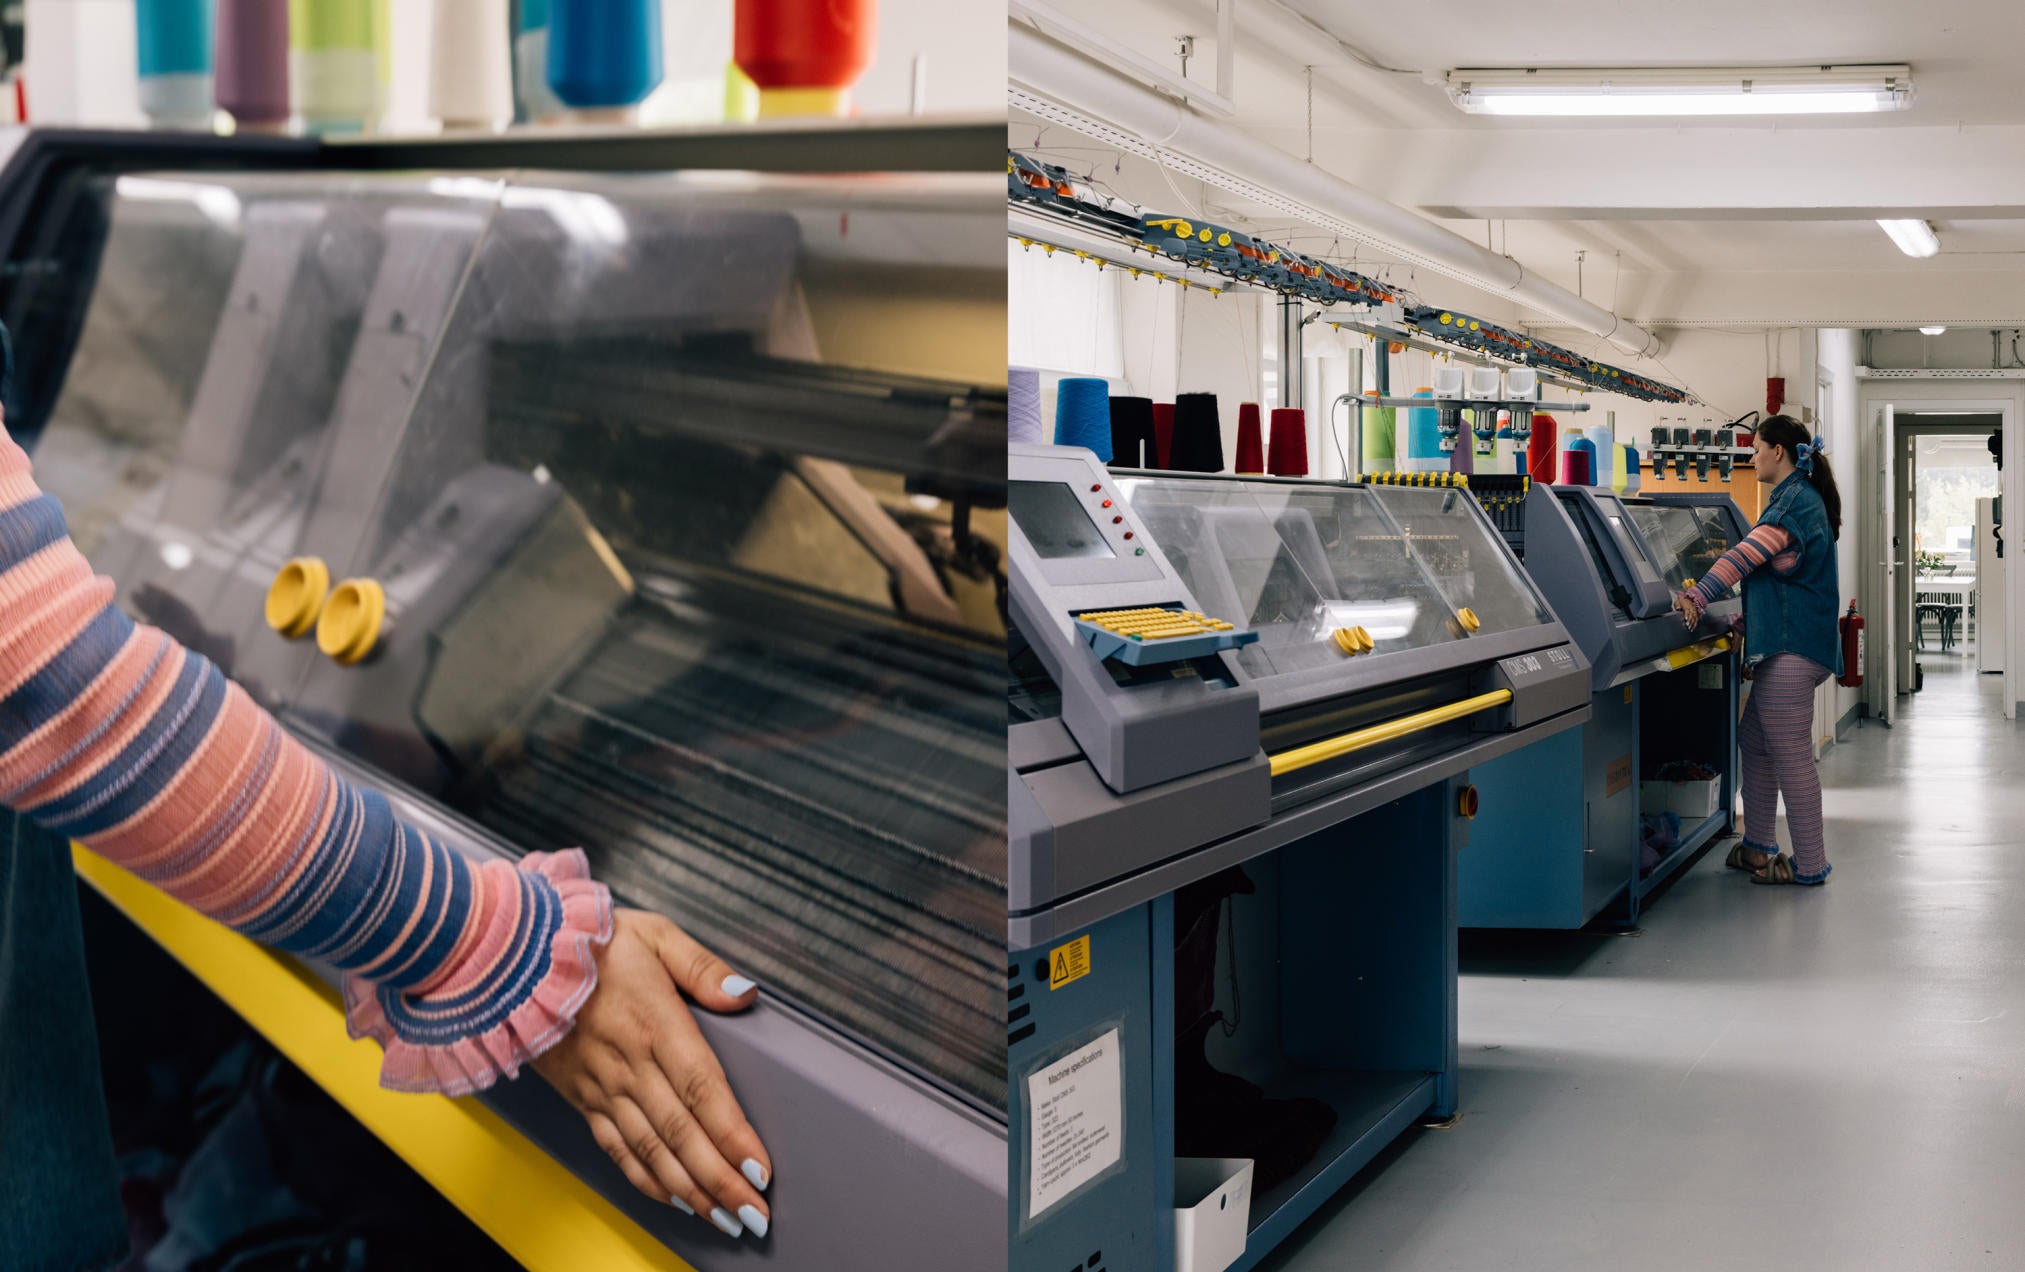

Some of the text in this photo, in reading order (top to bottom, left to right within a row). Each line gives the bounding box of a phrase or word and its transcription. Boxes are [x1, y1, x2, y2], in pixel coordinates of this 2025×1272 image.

[1546, 649, 1570, 662] STOLL
[1048, 1048, 1103, 1085] Machine specifications
